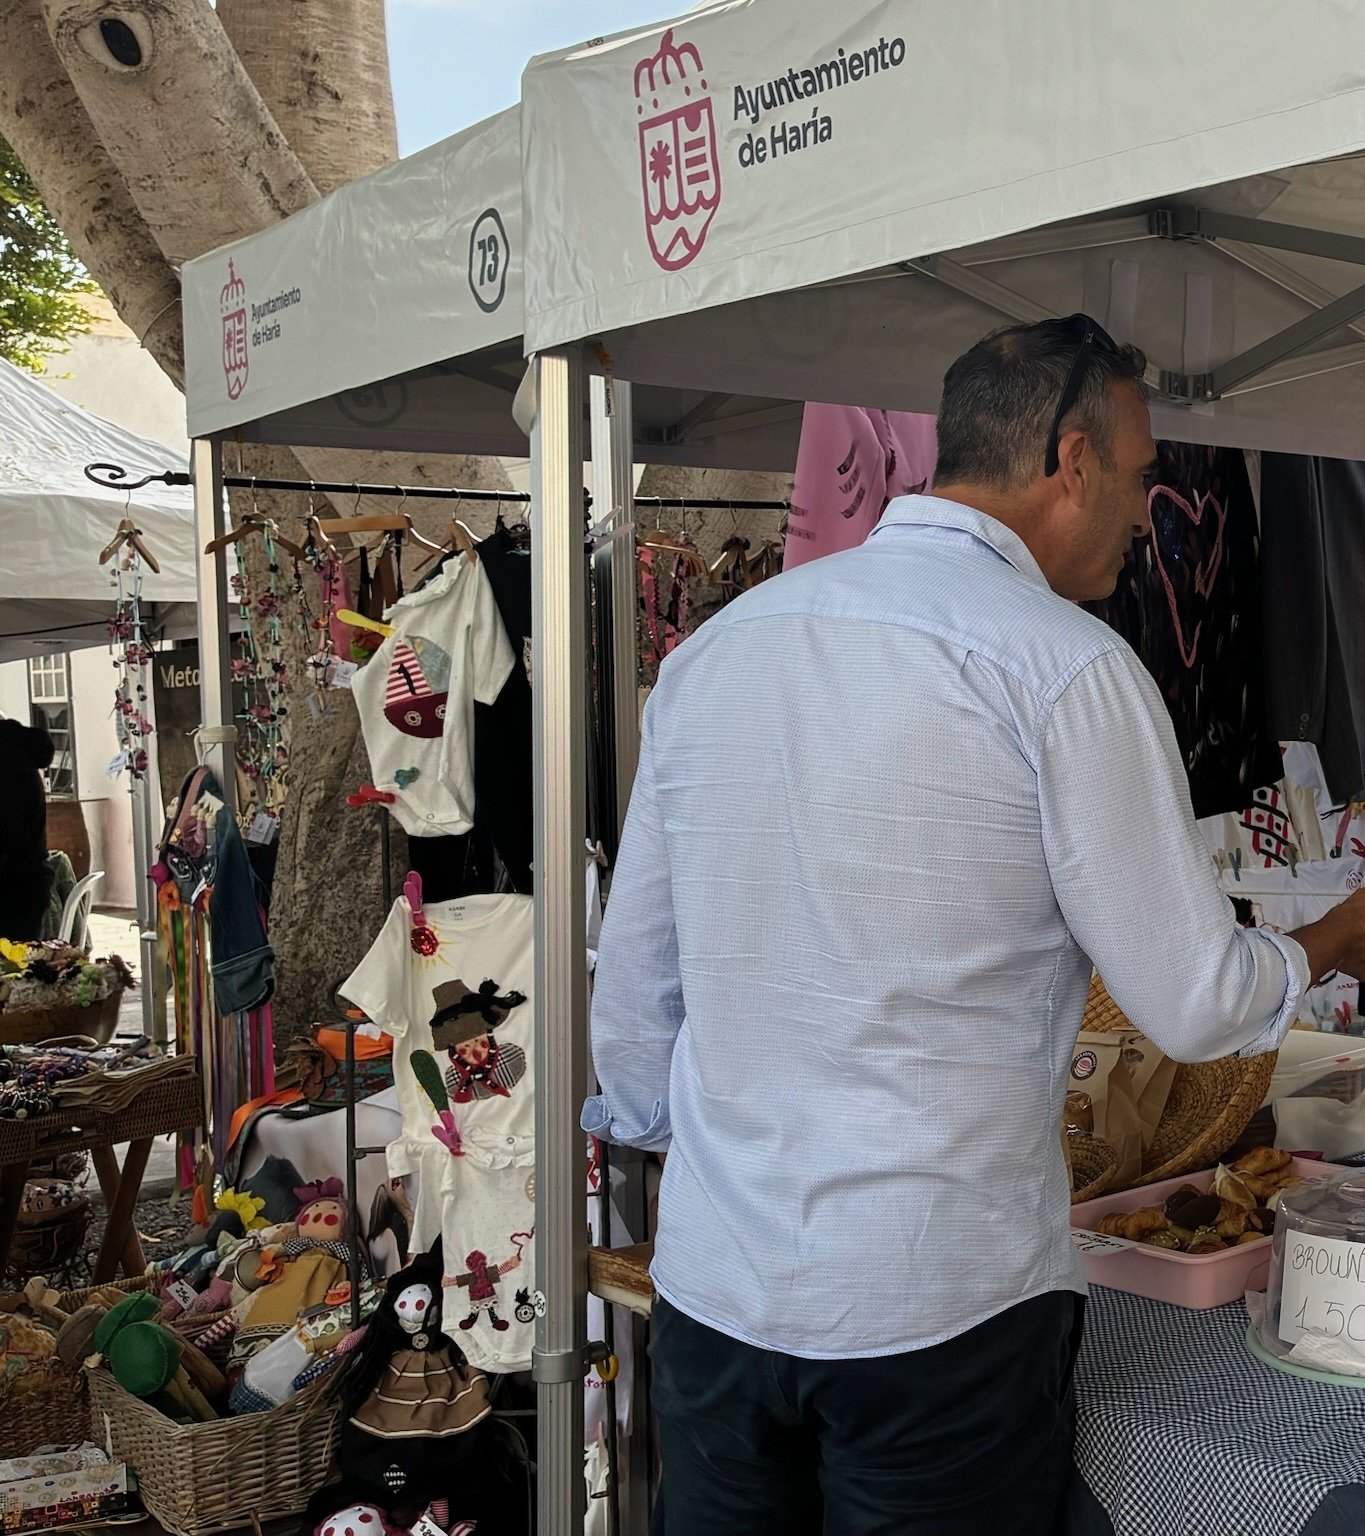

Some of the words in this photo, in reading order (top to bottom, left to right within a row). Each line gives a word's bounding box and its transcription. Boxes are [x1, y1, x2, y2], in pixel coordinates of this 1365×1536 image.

[733, 37, 906, 124] Ayuntamiento
[738, 133, 767, 168] de
[770, 106, 832, 158] Haría
[477, 234, 499, 287] 73
[251, 286, 301, 325] Ayuntamiento
[252, 328, 261, 348] de
[262, 318, 281, 344] Haría
